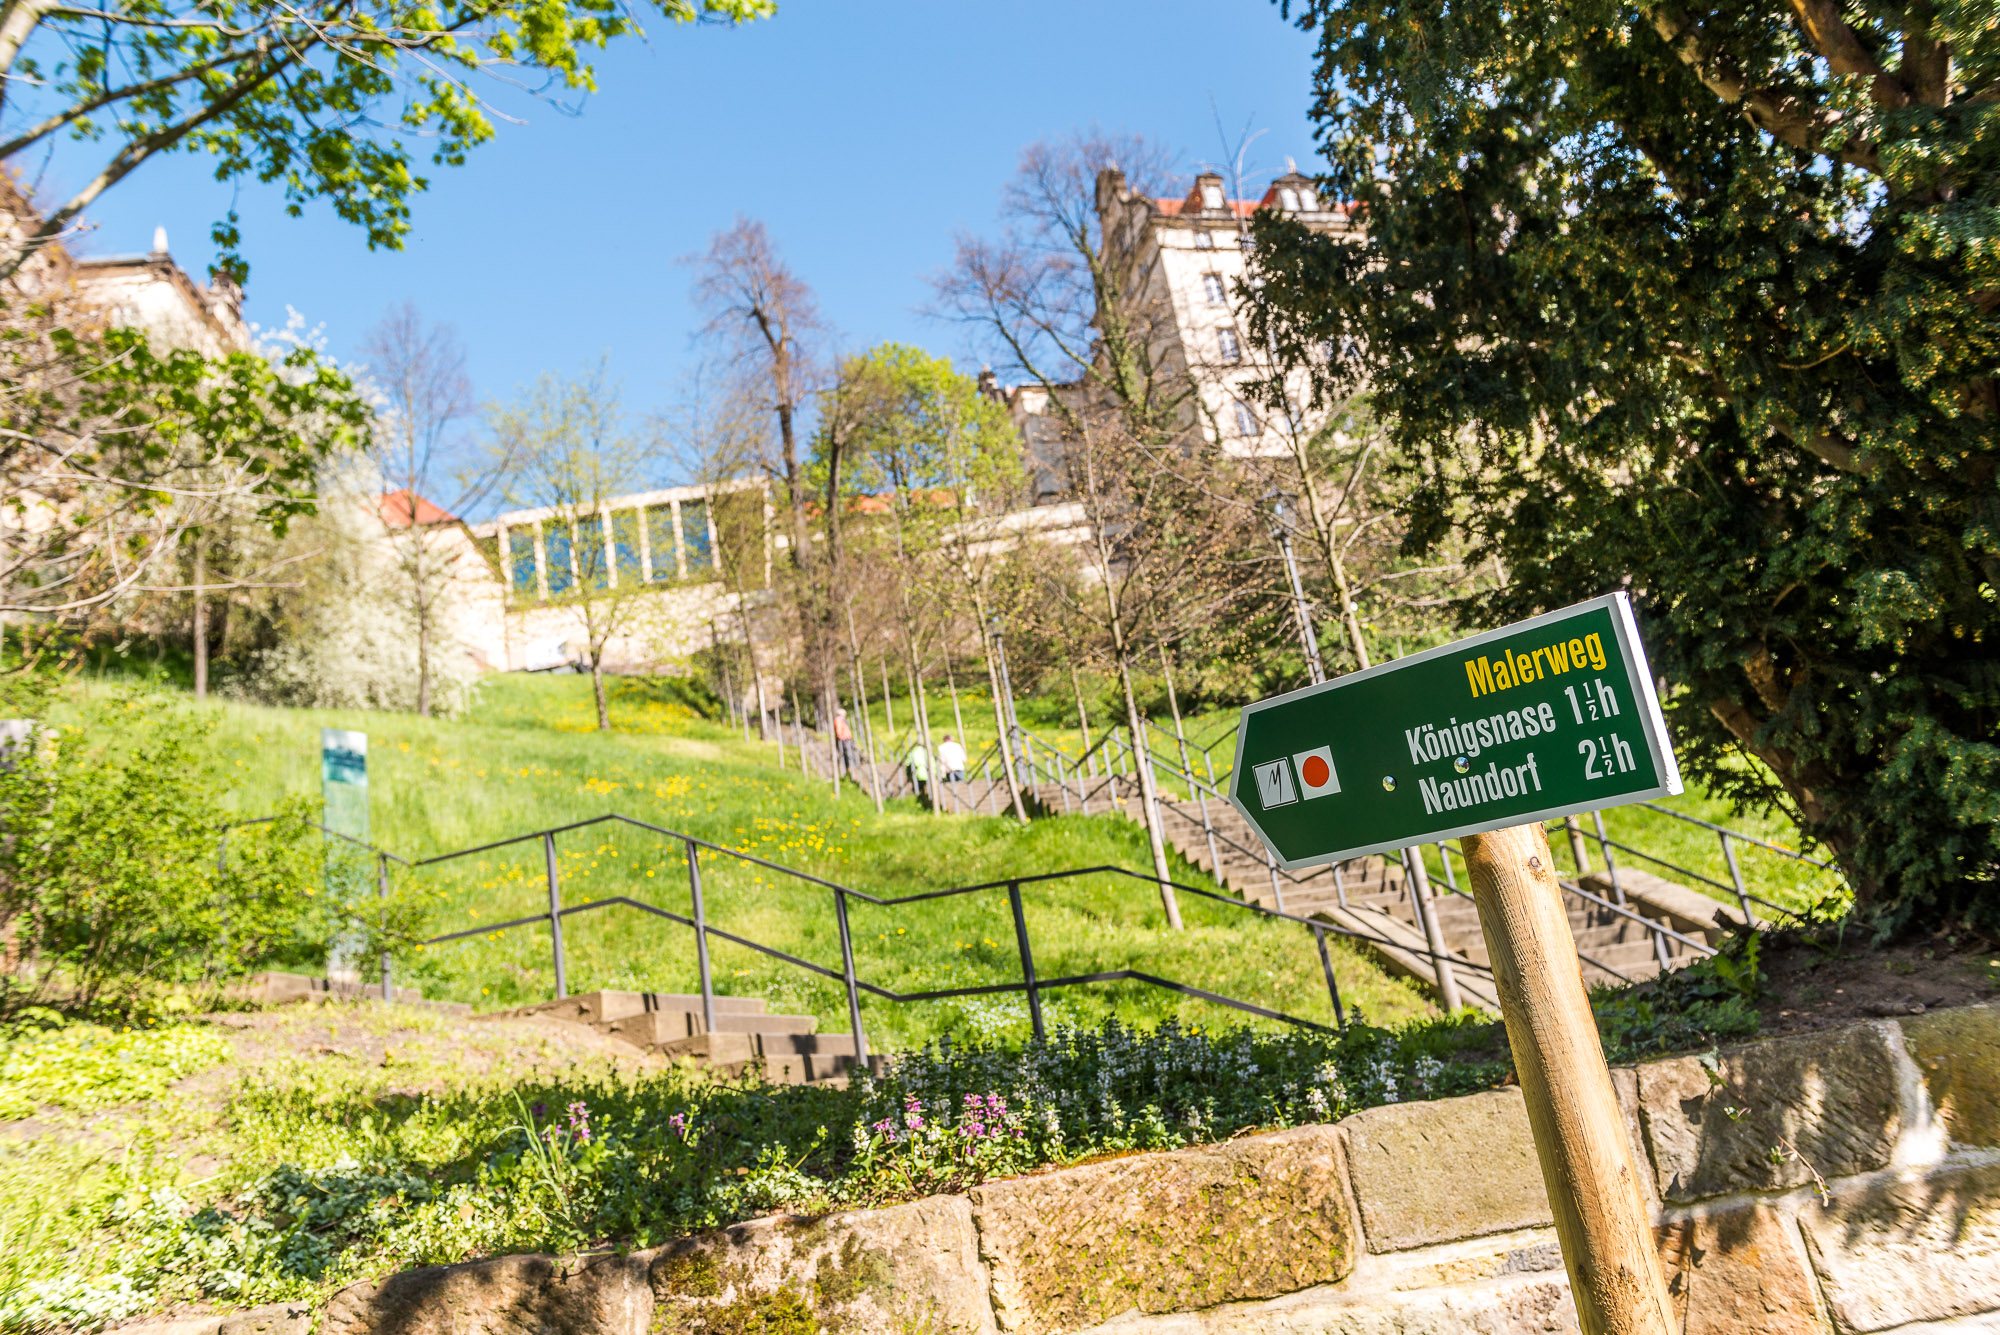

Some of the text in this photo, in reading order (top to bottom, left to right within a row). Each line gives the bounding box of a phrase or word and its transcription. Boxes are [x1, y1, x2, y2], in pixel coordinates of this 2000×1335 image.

[1465, 632, 1607, 698] Malerweg
[1405, 702, 1556, 765] Königsnase
[1418, 752, 1543, 815] Naundorf
